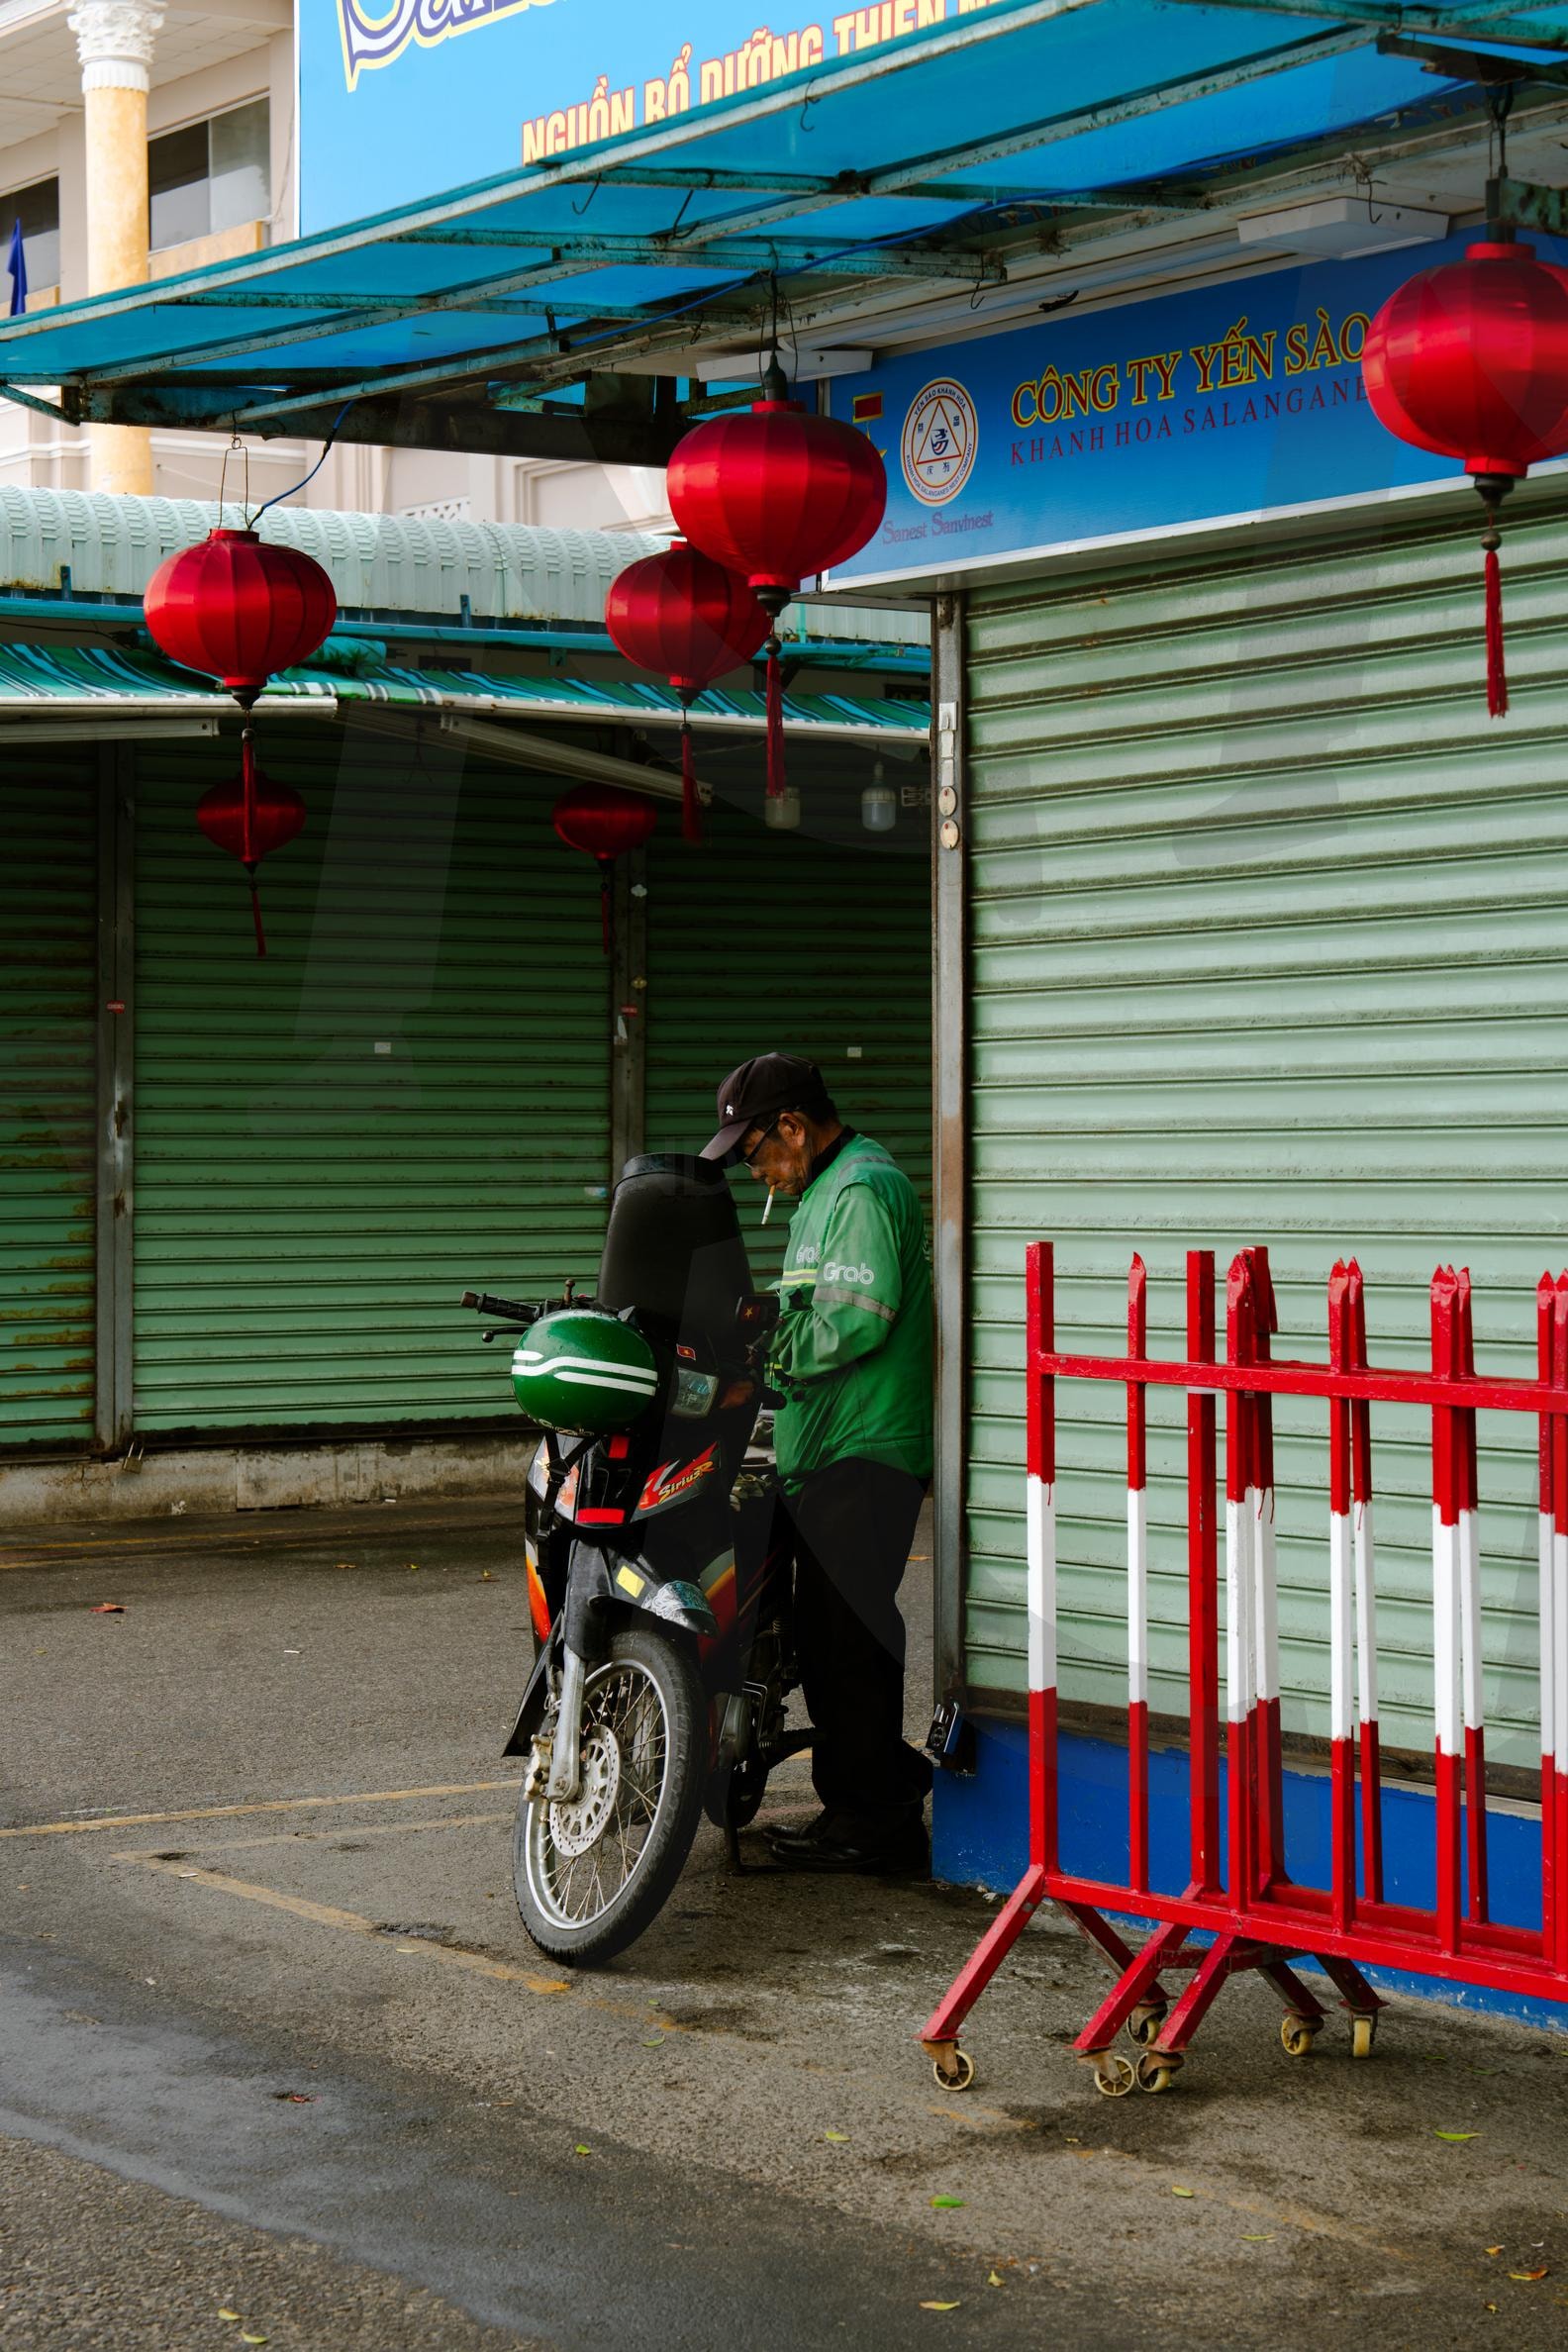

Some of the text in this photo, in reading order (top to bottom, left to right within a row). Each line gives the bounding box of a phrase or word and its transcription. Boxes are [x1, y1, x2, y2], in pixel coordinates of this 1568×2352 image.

[644, 43, 692, 128] BỔ
[1012, 307, 1372, 429] CÔNG TY YẾN SÀO
[1011, 426, 1106, 467] KHANH
[1116, 413, 1172, 446] HOA
[824, 1261, 875, 1285] Grab
